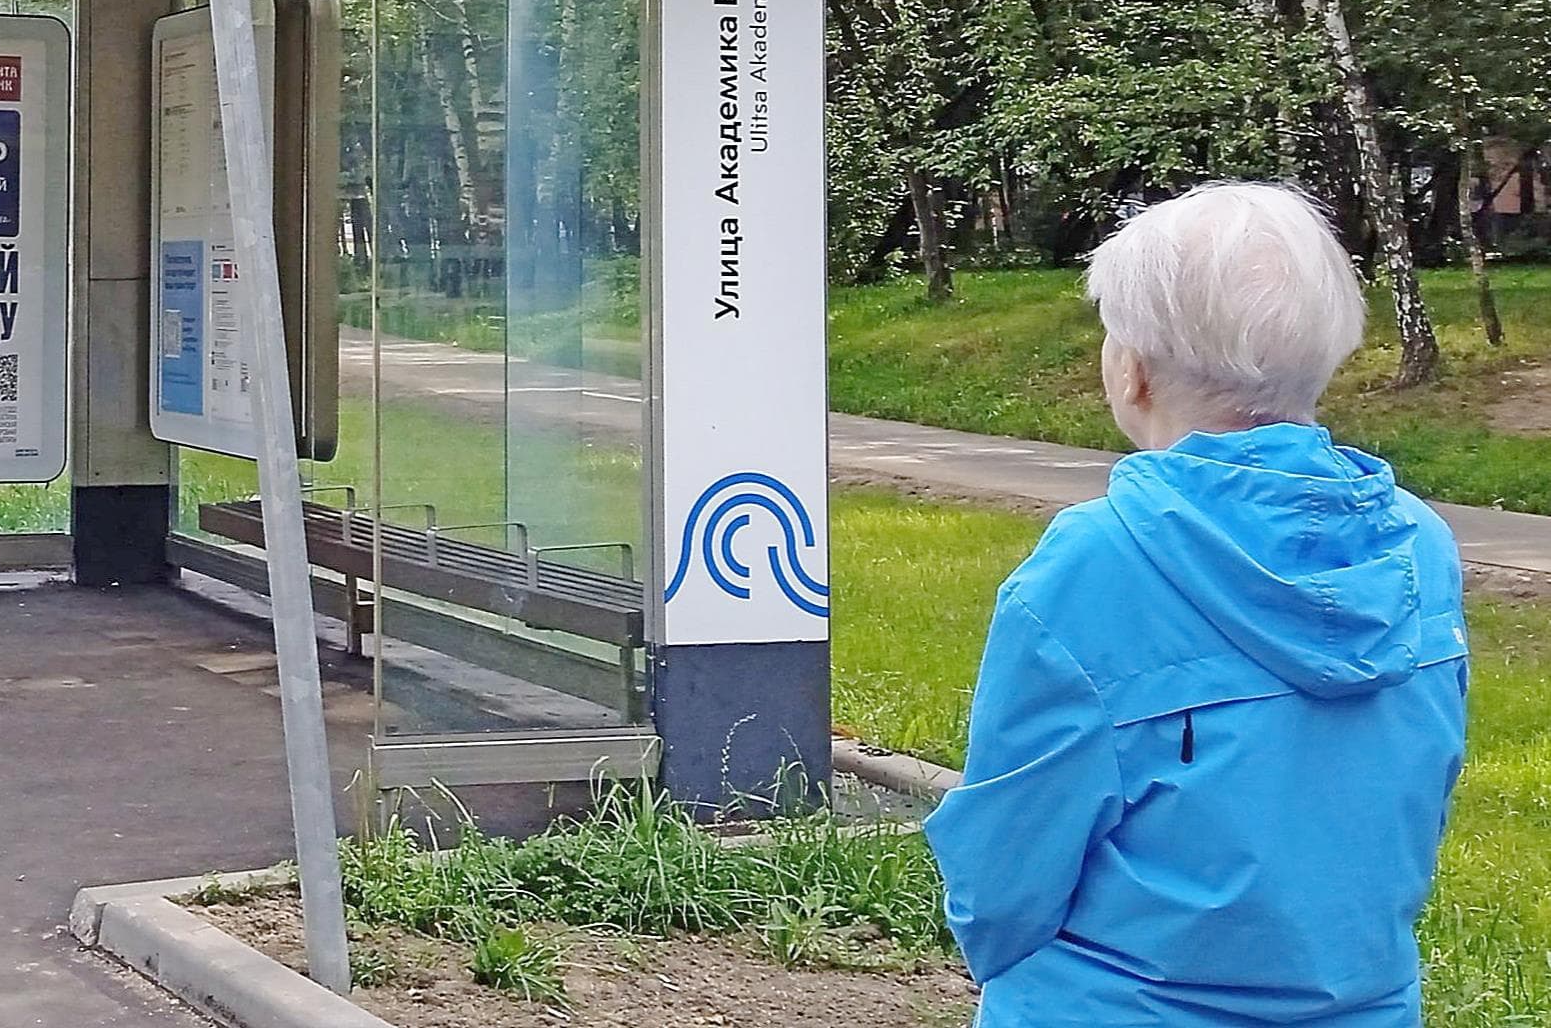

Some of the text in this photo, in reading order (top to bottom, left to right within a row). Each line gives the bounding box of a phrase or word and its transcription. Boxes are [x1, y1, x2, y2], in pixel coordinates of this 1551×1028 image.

[714, 16, 743, 205] Академика
[749, 91, 768, 153] Ulitsa
[714, 218, 743, 319] Улица
